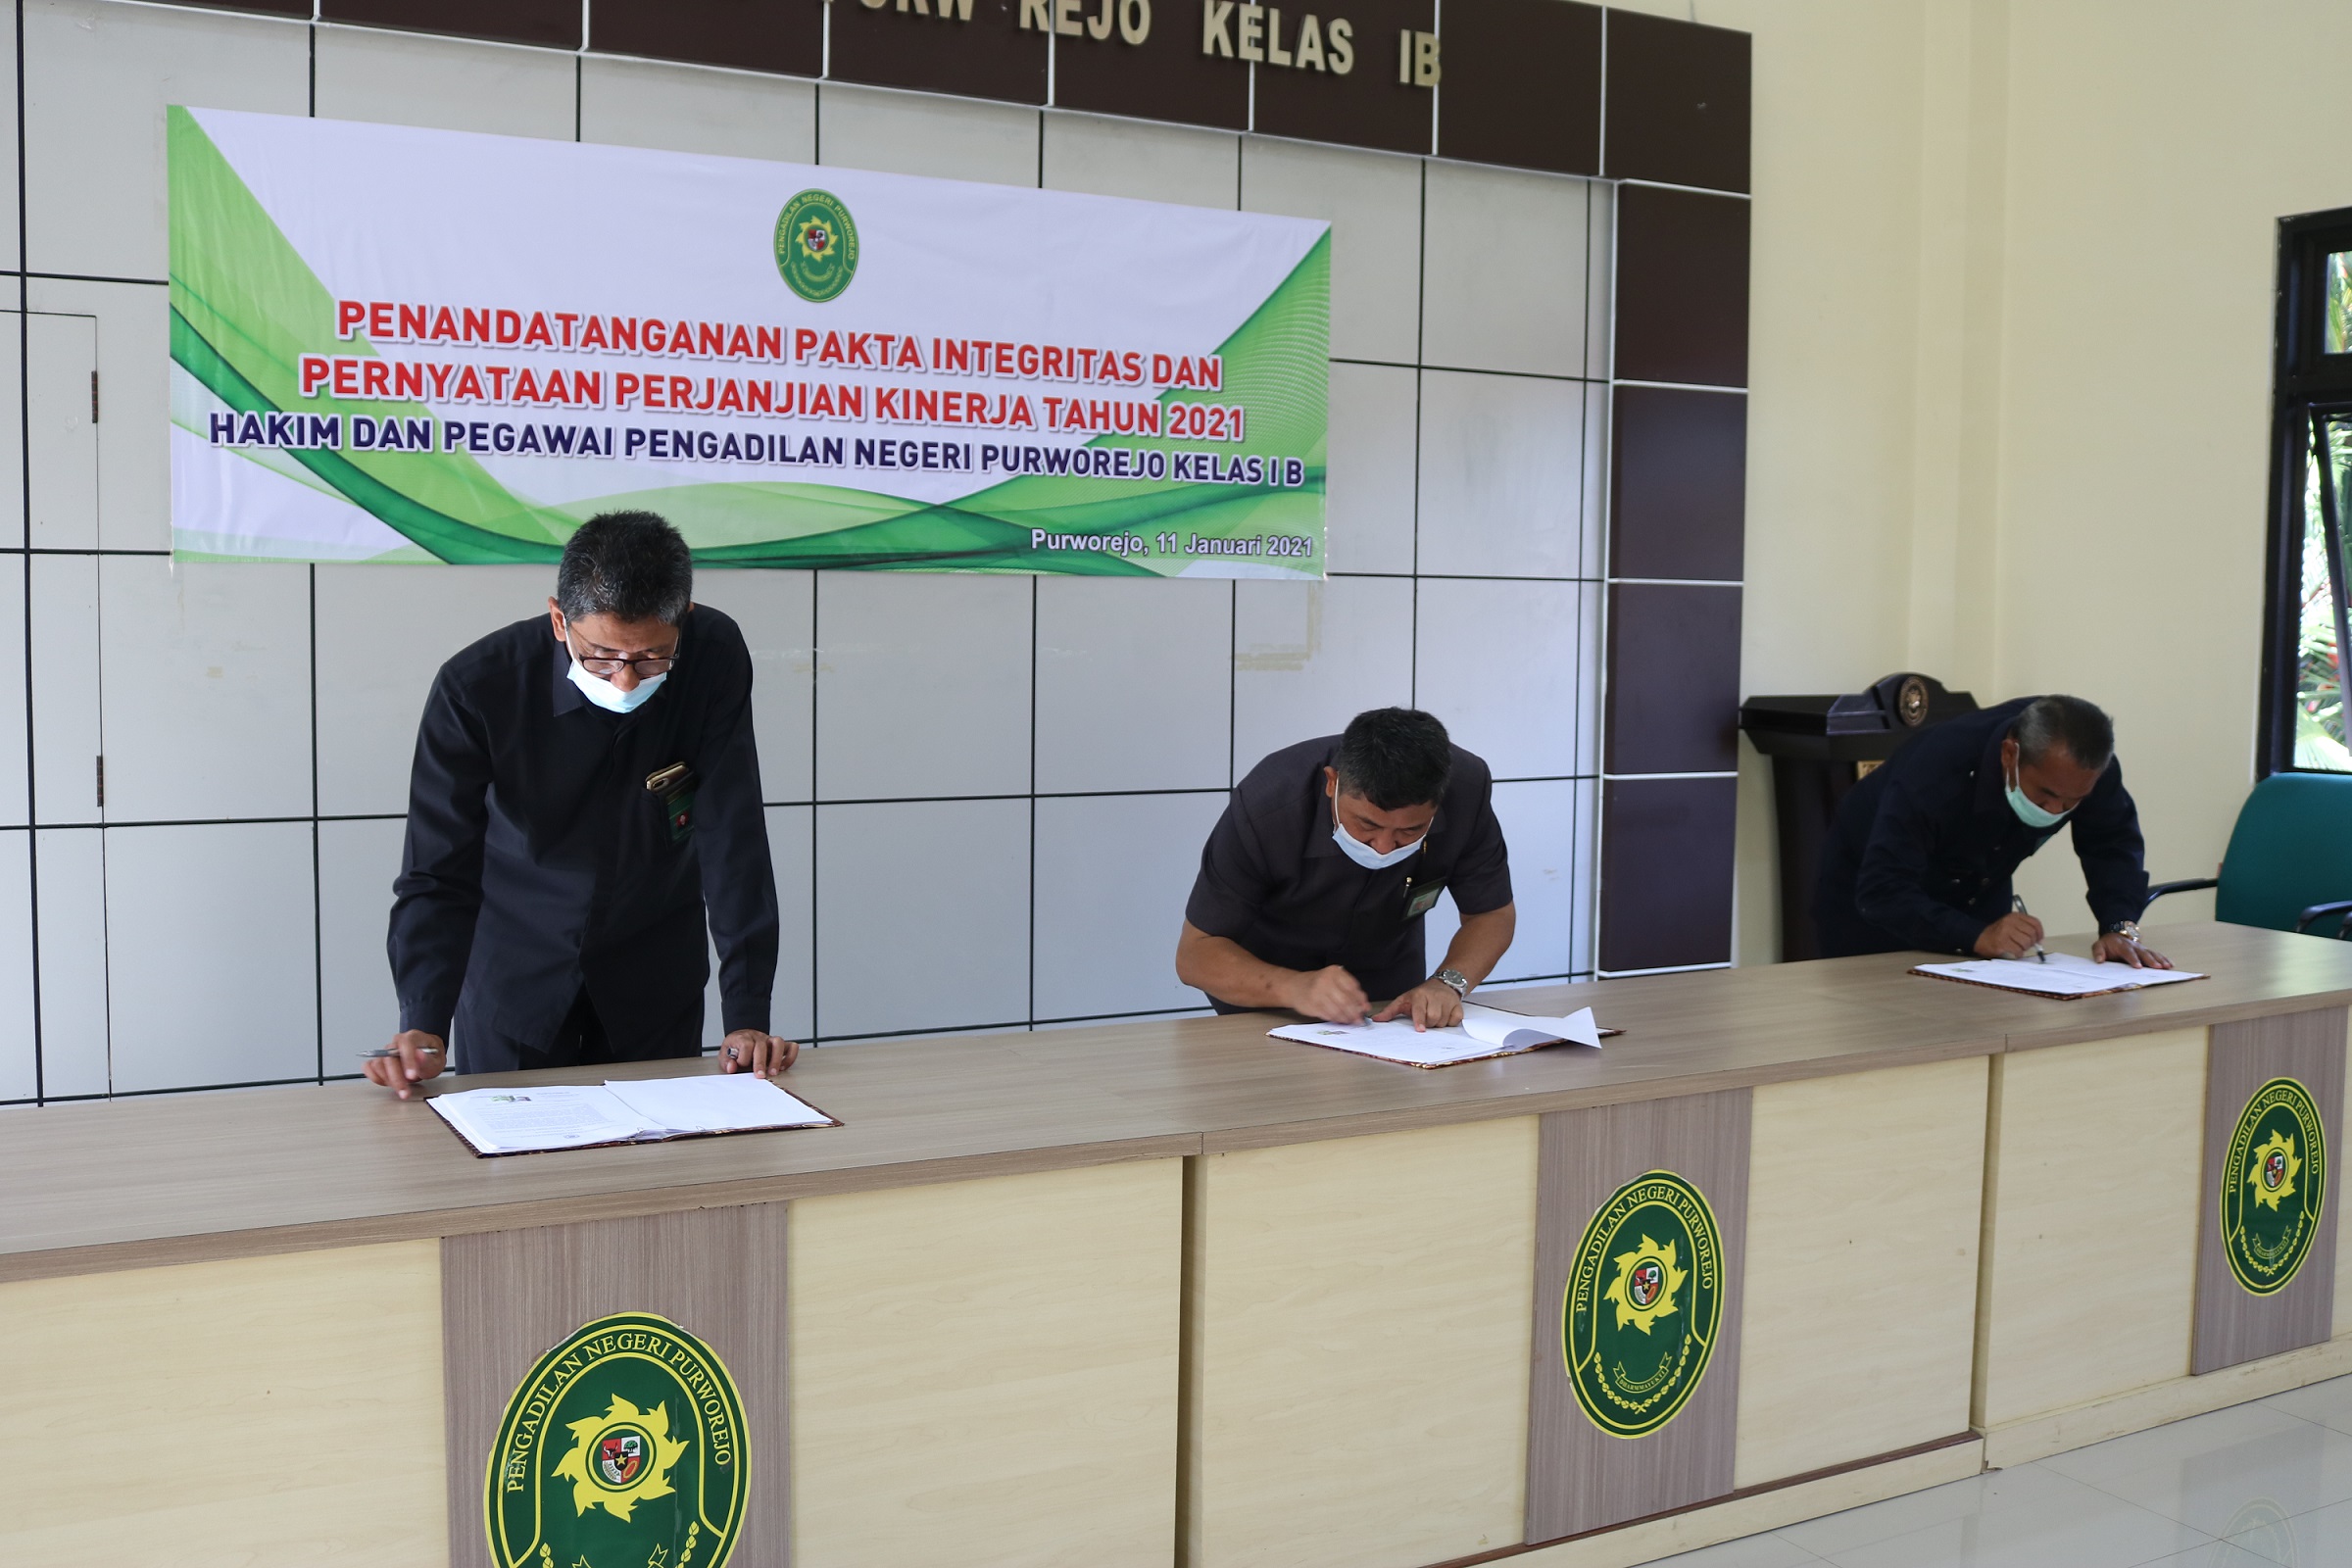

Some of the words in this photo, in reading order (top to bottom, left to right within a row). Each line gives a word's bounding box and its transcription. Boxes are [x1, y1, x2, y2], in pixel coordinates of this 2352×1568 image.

[1202, 0, 1354, 75] KELAS
[1399, 28, 1442, 87] IB
[778, 201, 801, 254] PENGADILAN
[802, 194, 834, 206] NEGERI
[835, 205, 856, 260] PURWOREJO
[338, 300, 782, 360] PENANDATANGANAN
[795, 327, 922, 368] PAKTA
[933, 337, 1143, 383] INTEGRITAS
[1152, 354, 1219, 388] DAN
[303, 358, 602, 405] PERNYATAAN
[615, 371, 862, 418] PERJANJIAN
[875, 386, 1033, 426] KINERJA
[1042, 396, 1159, 434] TAHUN
[1169, 405, 1243, 439] 2021
[210, 413, 340, 448] HAKIM
[352, 417, 431, 450] DAN
[444, 421, 613, 457] PEGAWAI
[624, 428, 844, 465] PENGADILAN
[854, 438, 971, 470] NEGERI
[981, 444, 1165, 479] PURWOREJO
[1173, 454, 1263, 484] KELAS
[1030, 527, 1149, 556] Purworejo,
[1155, 532, 1177, 554] 11
[1184, 533, 1262, 556] Januari
[1267, 535, 1312, 557] 2021
[2229, 1104, 2263, 1194] PENGADILAN
[2262, 1089, 2297, 1106] NEGERI
[2295, 1100, 2320, 1175] PURWOREJO
[1576, 1202, 1627, 1312] PENGADILAN
[1627, 1185, 1679, 1209] NEGERI
[1677, 1198, 1714, 1290] PURWOREJO
[507, 1352, 584, 1493] PENGADILAN
[583, 1332, 672, 1361] NEGERI
[668, 1348, 732, 1466] PURWOREJO
